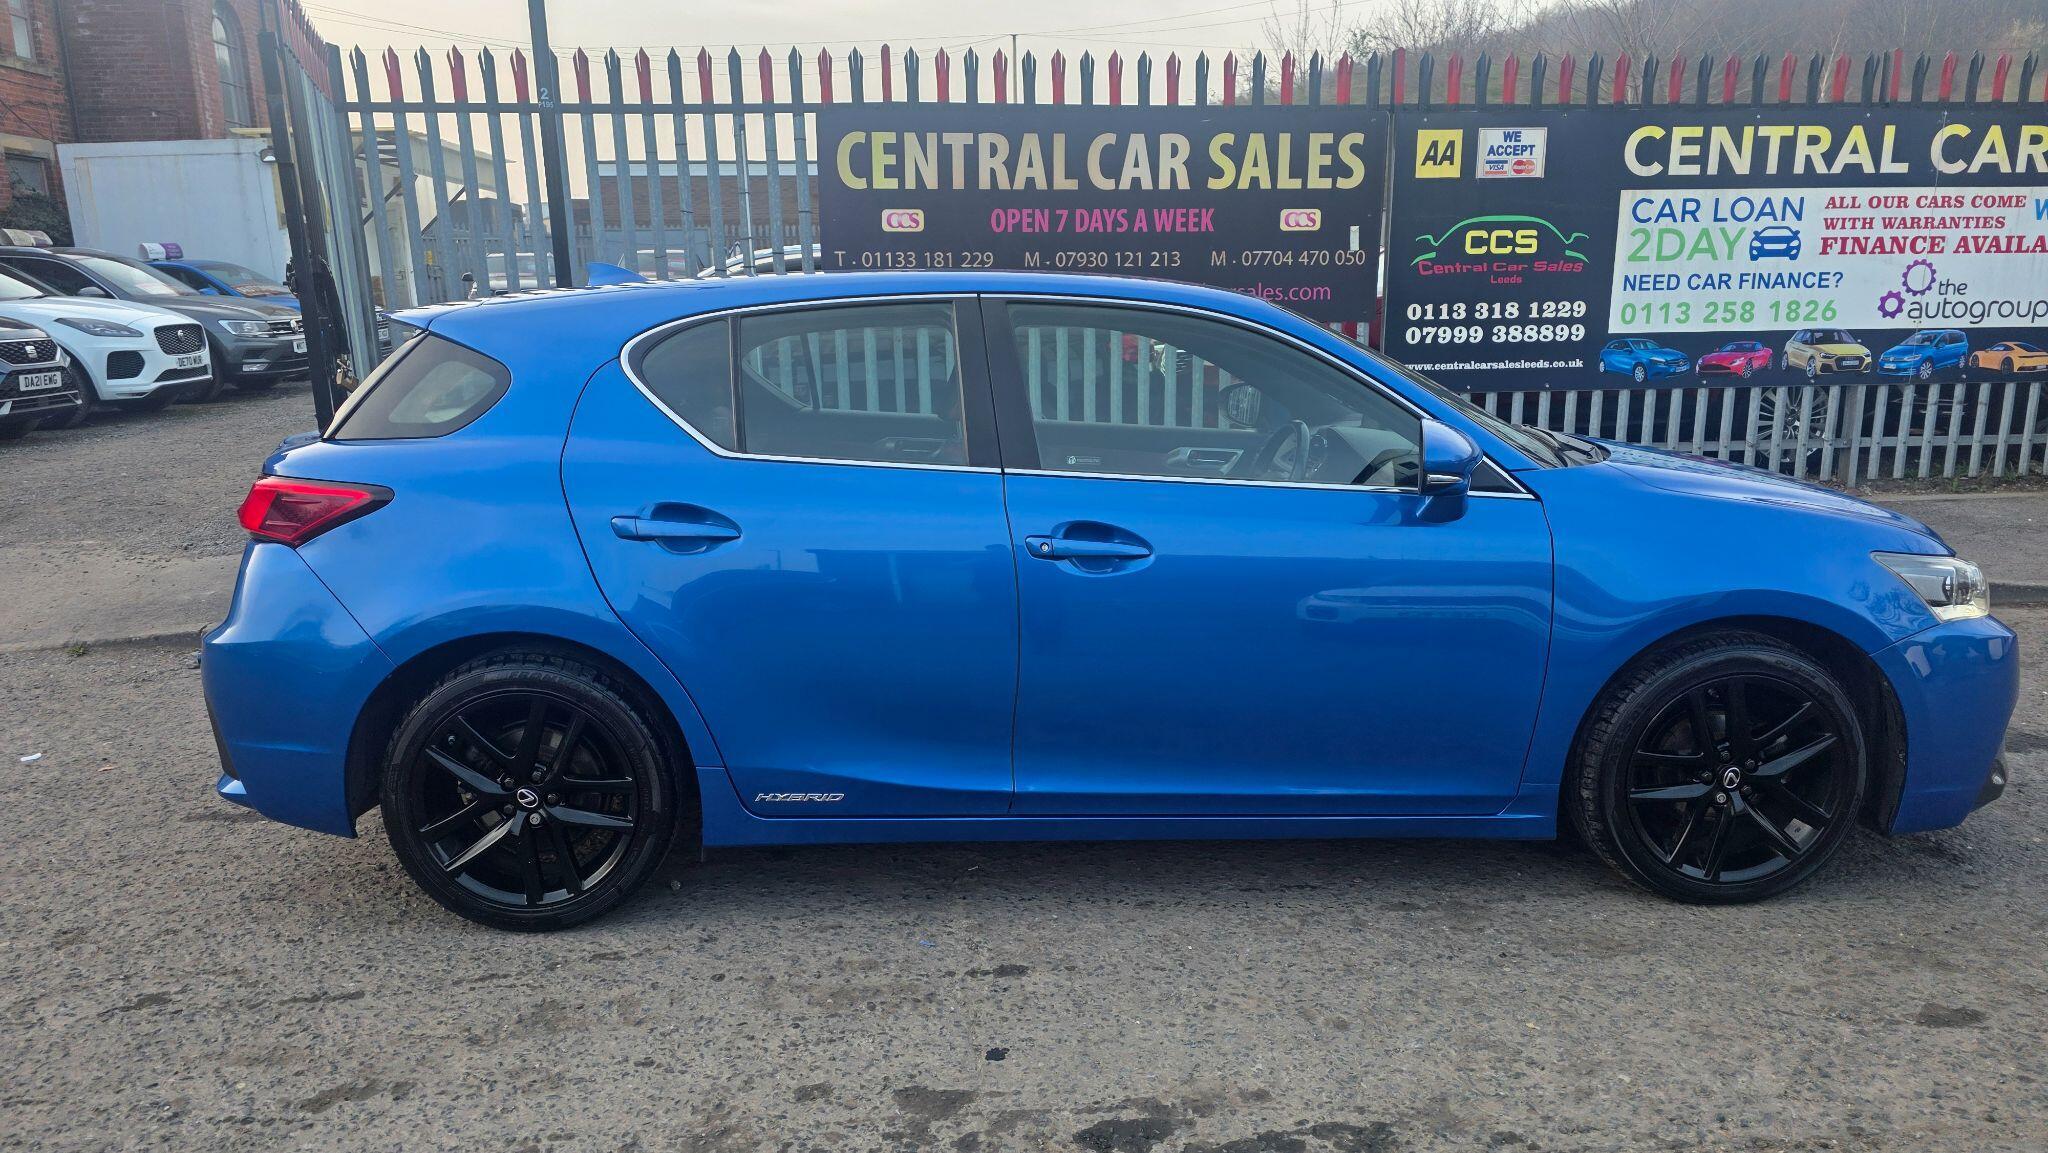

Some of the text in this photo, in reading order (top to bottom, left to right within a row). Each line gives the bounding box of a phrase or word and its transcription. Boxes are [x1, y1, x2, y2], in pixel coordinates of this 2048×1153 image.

[541, 87, 549, 100] 2
[1503, 131, 1522, 143] WE
[1421, 140, 1456, 166] AA
[1487, 145, 1536, 157] ACCEPT
[1624, 124, 2048, 177] CENTRAL CAR
[836, 131, 1365, 190] CENTRAL CAR SALES
[1632, 196, 1805, 223] CAR LOAN
[1825, 194, 2027, 209] ALL OUR CARS COME
[886, 212, 920, 229] CCS
[990, 208, 1215, 233] OPEN 7 DAYS A WEEK
[1284, 212, 1317, 228] CCS
[1823, 216, 2006, 230] WITH WARRANTIES
[1465, 230, 1538, 255] CCS
[1627, 227, 1747, 262] 2DAY
[1819, 235, 2048, 255] FINANCE AVAILA
[861, 251, 917, 267] 01133
[925, 251, 953, 267] 181
[961, 251, 994, 267] 229
[1055, 251, 1108, 267] 07930
[1115, 251, 1143, 266] 121
[1150, 251, 1181, 266] 213
[1242, 251, 1294, 265] 07704
[1299, 250, 1330, 265] 470
[1335, 250, 1366, 265] 050
[1418, 260, 1584, 275] Central Car Sales
[1490, 275, 1523, 284] Leeds
[1623, 271, 1844, 291] NEED CAR FINANCE?
[1938, 278, 1968, 296] the
[1407, 300, 1587, 321] 0113 318 1229
[1620, 299, 1838, 325] 0113 258 1826
[1907, 297, 2048, 324] autogroup
[1405, 323, 1586, 345] 07999 388899
[1405, 359, 1584, 371] www.centralcarsalesleeds.co.uk
[24, 375, 42, 388] DA21
[755, 793, 845, 802] HYBRID
